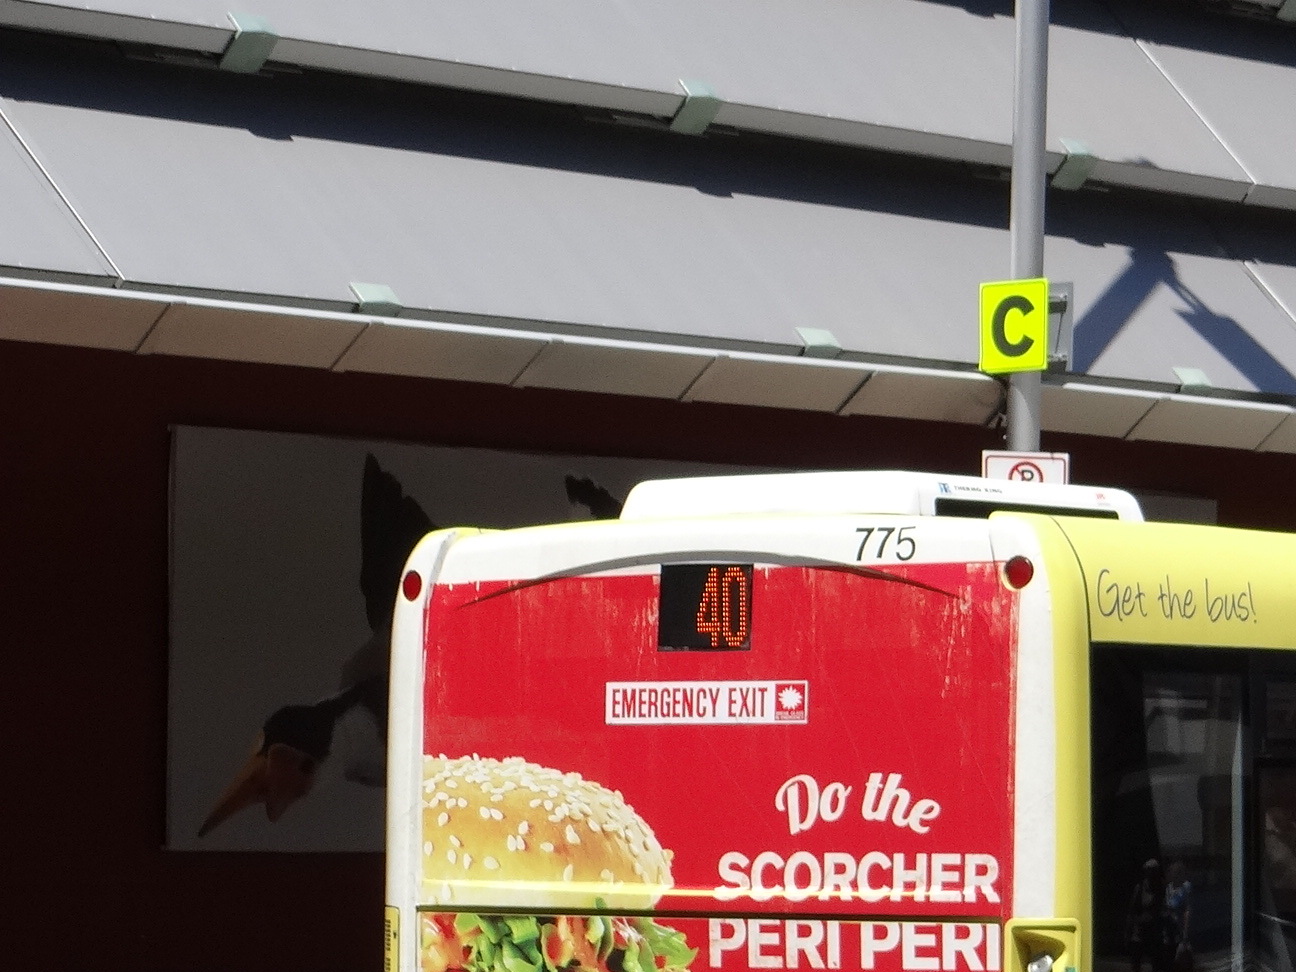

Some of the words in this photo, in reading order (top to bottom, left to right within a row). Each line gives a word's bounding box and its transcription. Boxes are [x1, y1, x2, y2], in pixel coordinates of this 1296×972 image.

[991, 295, 1035, 357] C
[854, 526, 917, 562] 775
[696, 566, 747, 647] 40
[1097, 569, 1148, 622] Get
[1158, 574, 1197, 620] the
[1204, 577, 1258, 623] bus!
[611, 687, 721, 719] EMERGENCY
[727, 687, 768, 718] EXIT
[775, 774, 852, 836] Do
[861, 772, 941, 834] the
[713, 850, 1001, 904] SCORCHER
[708, 917, 841, 970] PERI
[860, 921, 1001, 972] PERI
